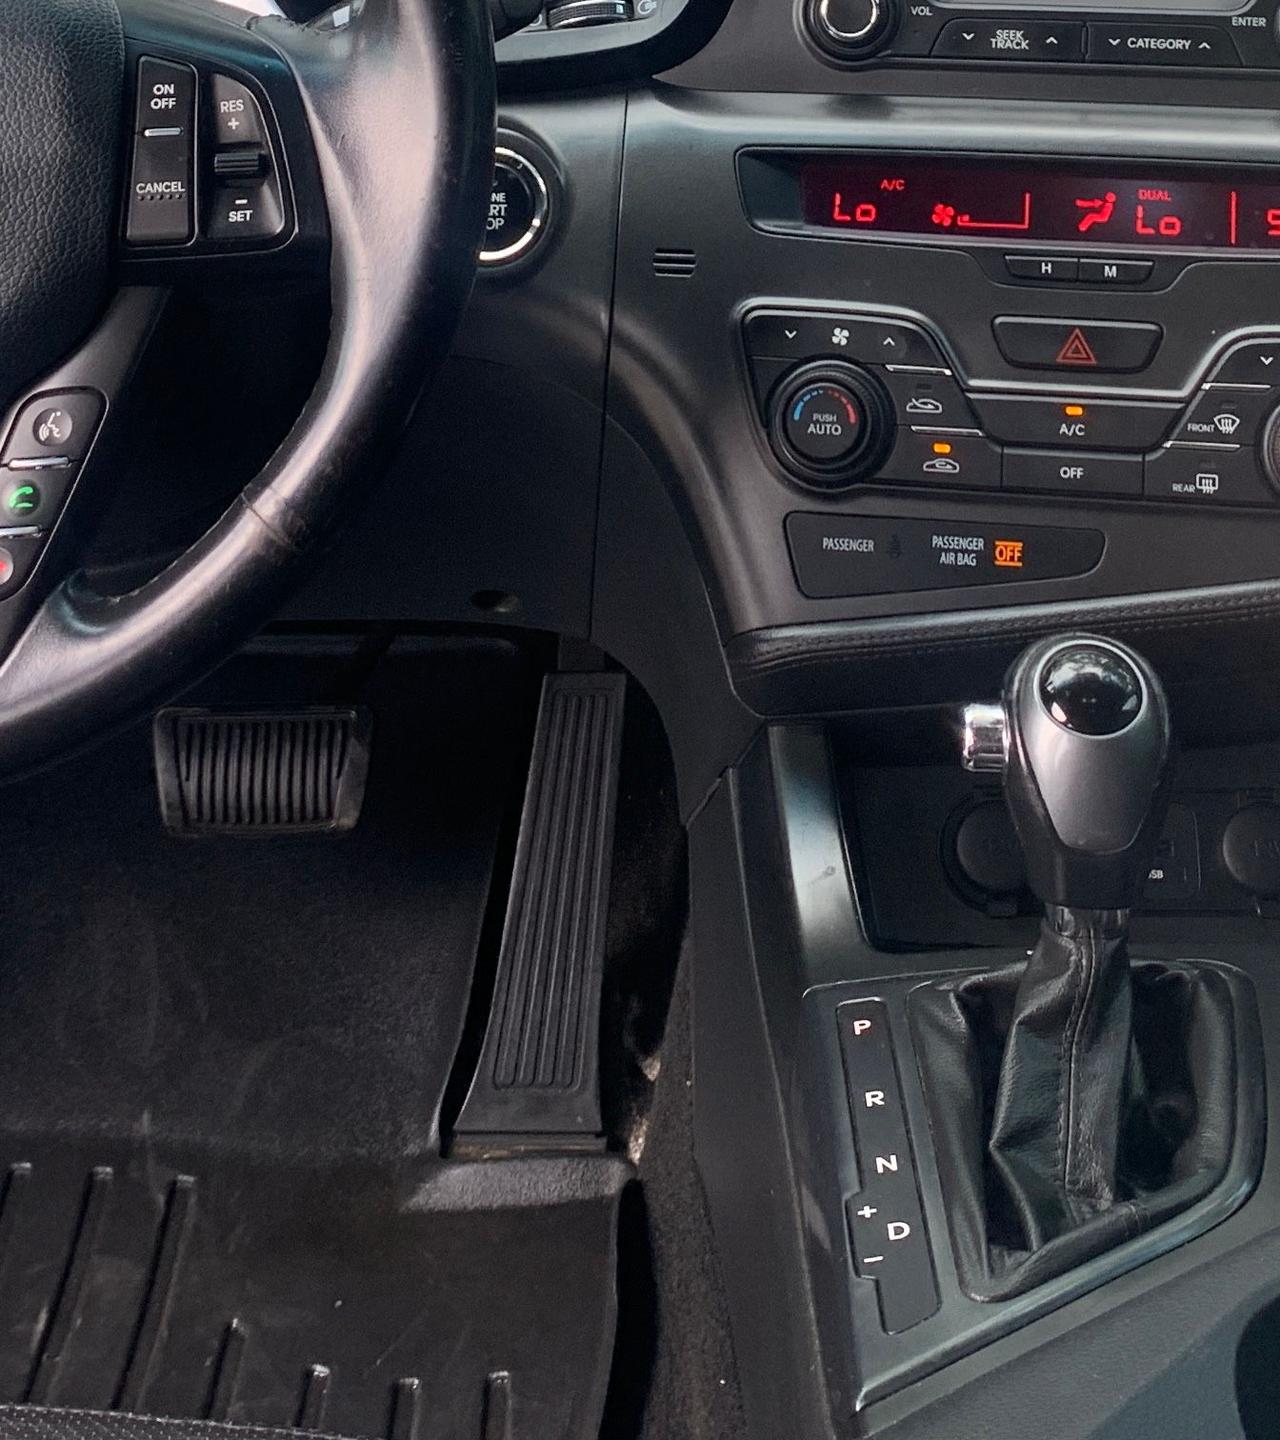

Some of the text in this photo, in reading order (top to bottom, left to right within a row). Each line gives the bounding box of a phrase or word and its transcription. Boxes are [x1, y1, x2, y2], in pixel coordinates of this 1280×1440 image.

[910, 6, 932, 17] VOL
[1231, 16, 1267, 28] ENTER
[996, 30, 1024, 41] SEEK
[990, 38, 1029, 50] TRACK
[1127, 38, 1191, 50] CATEGORY
[153, 84, 174, 94] ON
[150, 98, 176, 109] OFF
[220, 100, 244, 112] RES
[136, 182, 185, 194] CANCEL
[881, 177, 905, 192] A/C
[1138, 189, 1172, 202] DUAL
[228, 210, 253, 222] SET
[1041, 262, 1052, 274] H
[1103, 266, 1117, 278] M
[813, 413, 838, 423] PUSH
[807, 423, 842, 436] AUTO
[1059, 423, 1085, 436] A/C
[1187, 421, 1214, 434] FRONT
[1059, 466, 1084, 479] OFF
[1172, 482, 1195, 494] REAR
[822, 536, 874, 554] PASSENGER
[932, 534, 984, 553] PASSENGER
[939, 551, 977, 567] AIR BAG
[995, 542, 1022, 564] OFF
[853, 1020, 871, 1035] P
[865, 1091, 884, 1107] R
[876, 1154, 898, 1174] N
[887, 1221, 911, 1241] D
